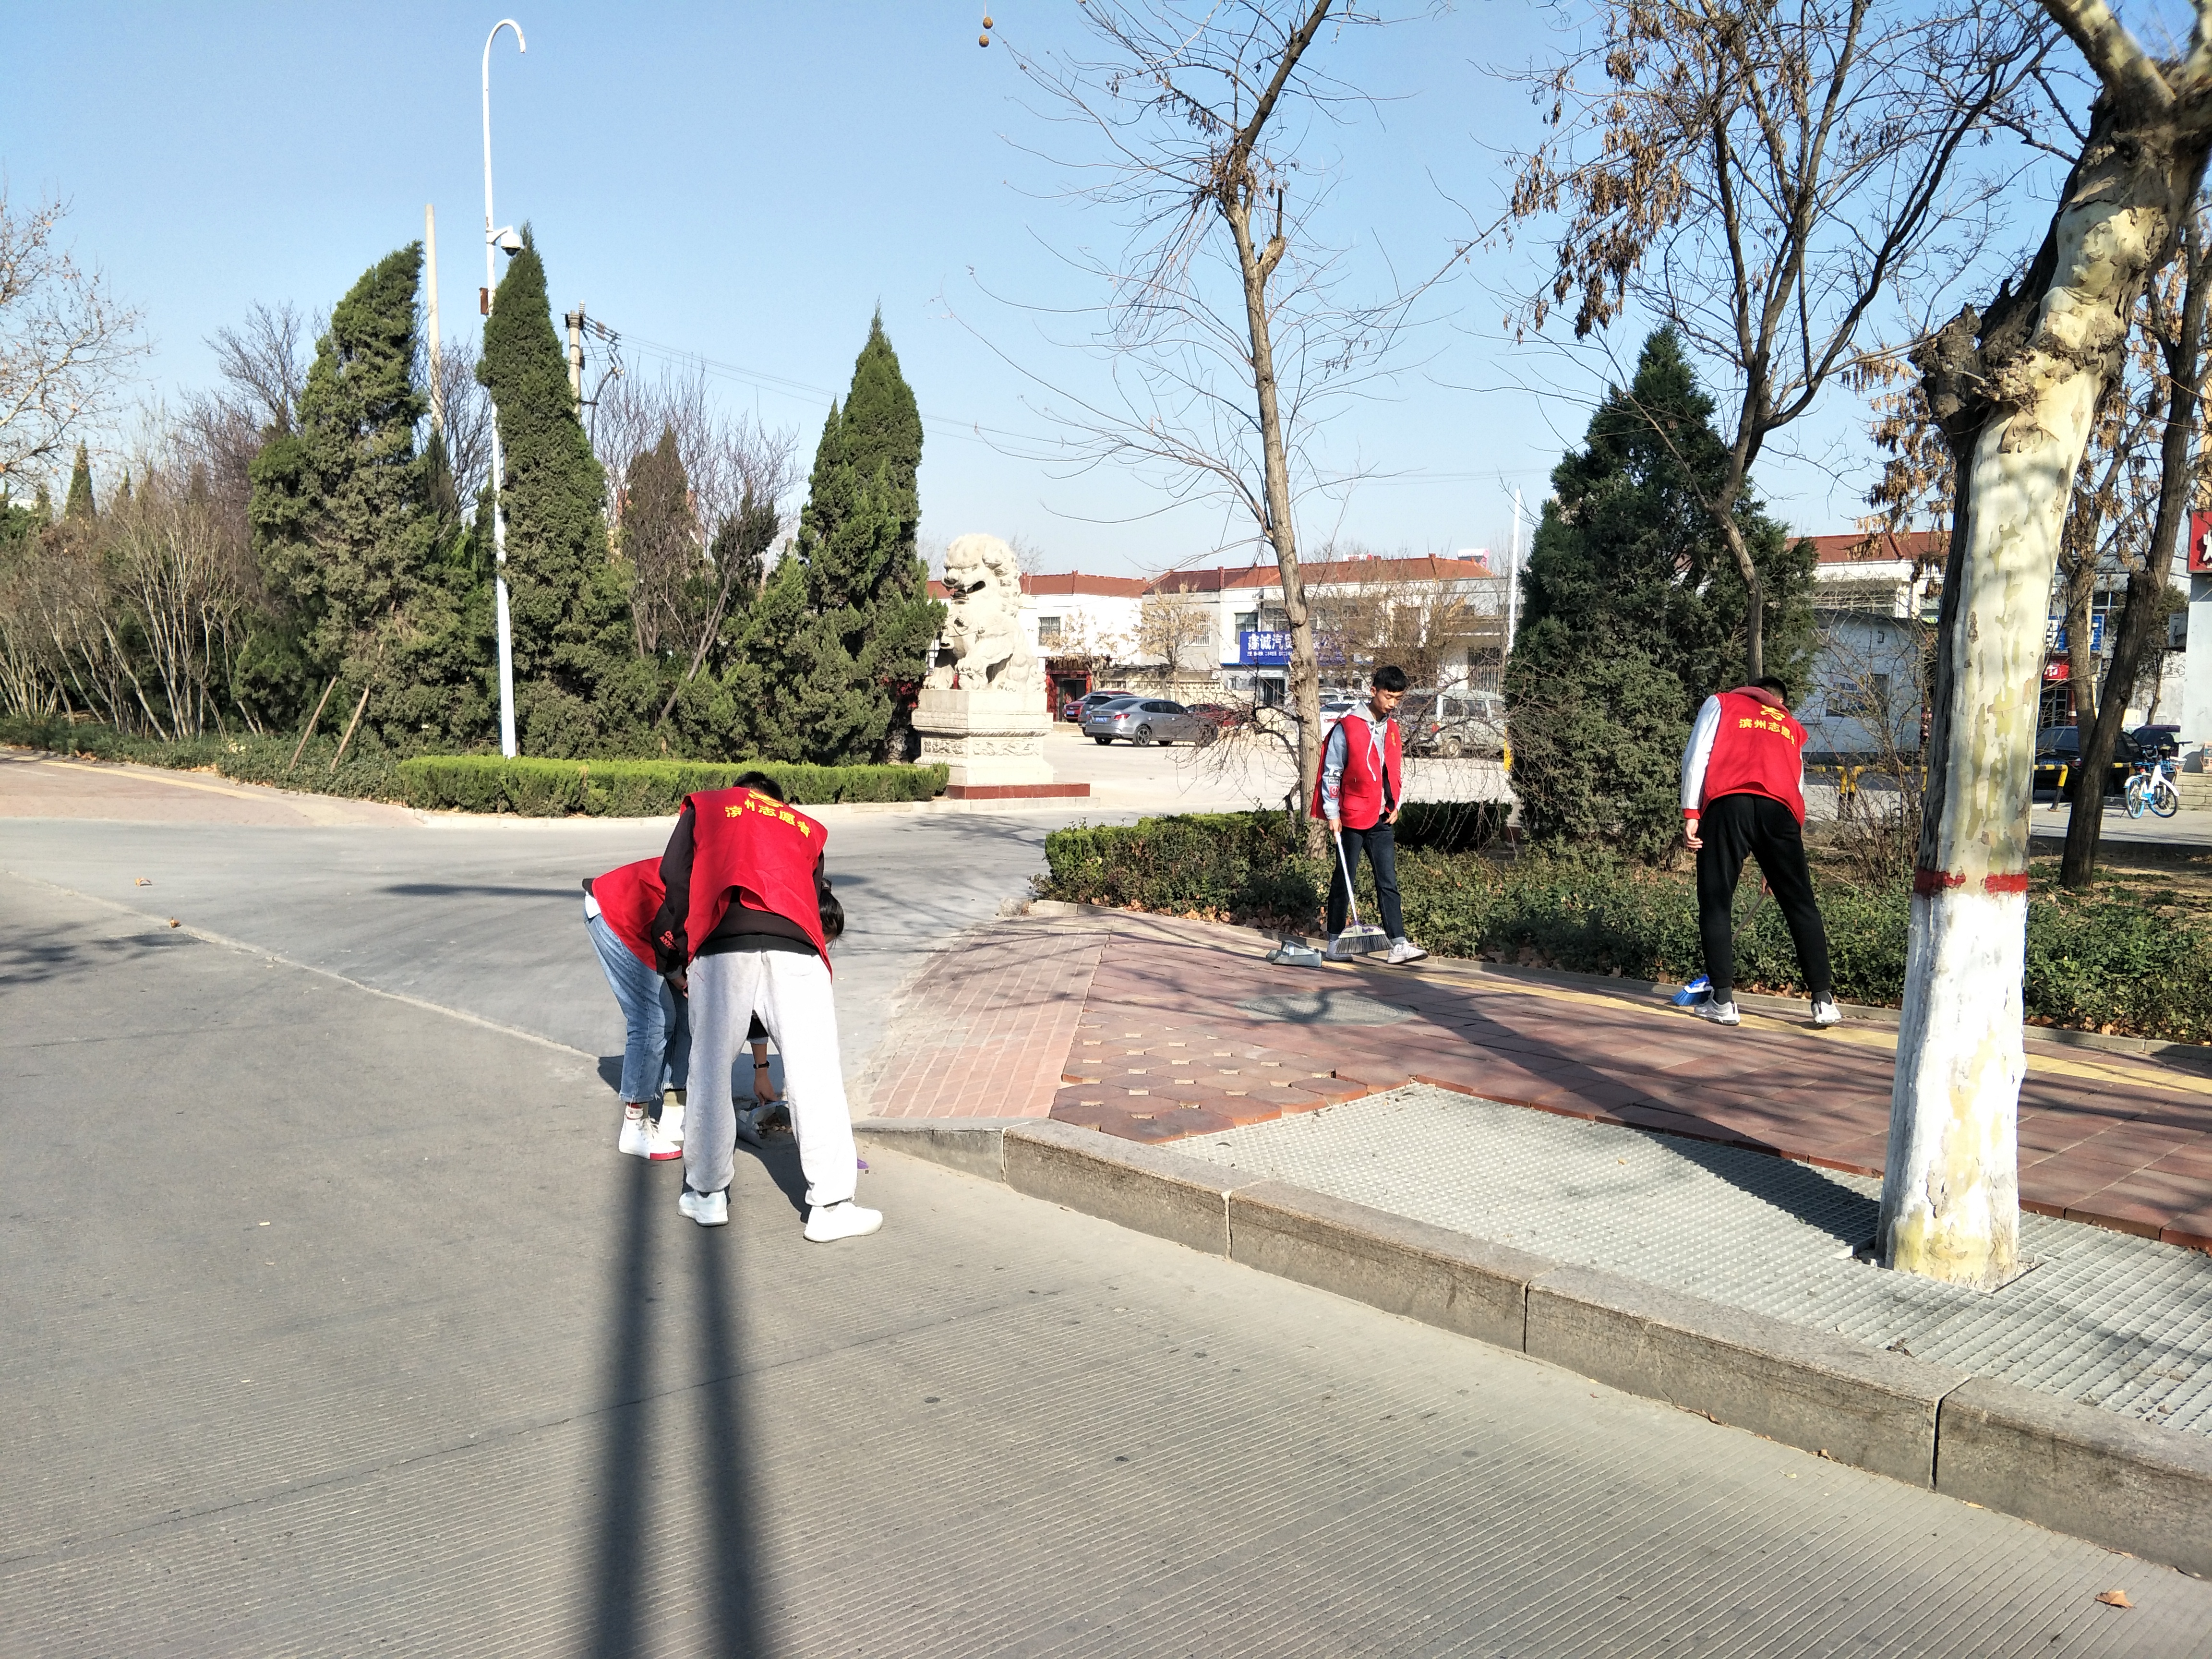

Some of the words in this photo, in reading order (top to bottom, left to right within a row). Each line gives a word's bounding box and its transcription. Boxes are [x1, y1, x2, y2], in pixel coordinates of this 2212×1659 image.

[724, 799, 811, 838] 滨州志愿者
